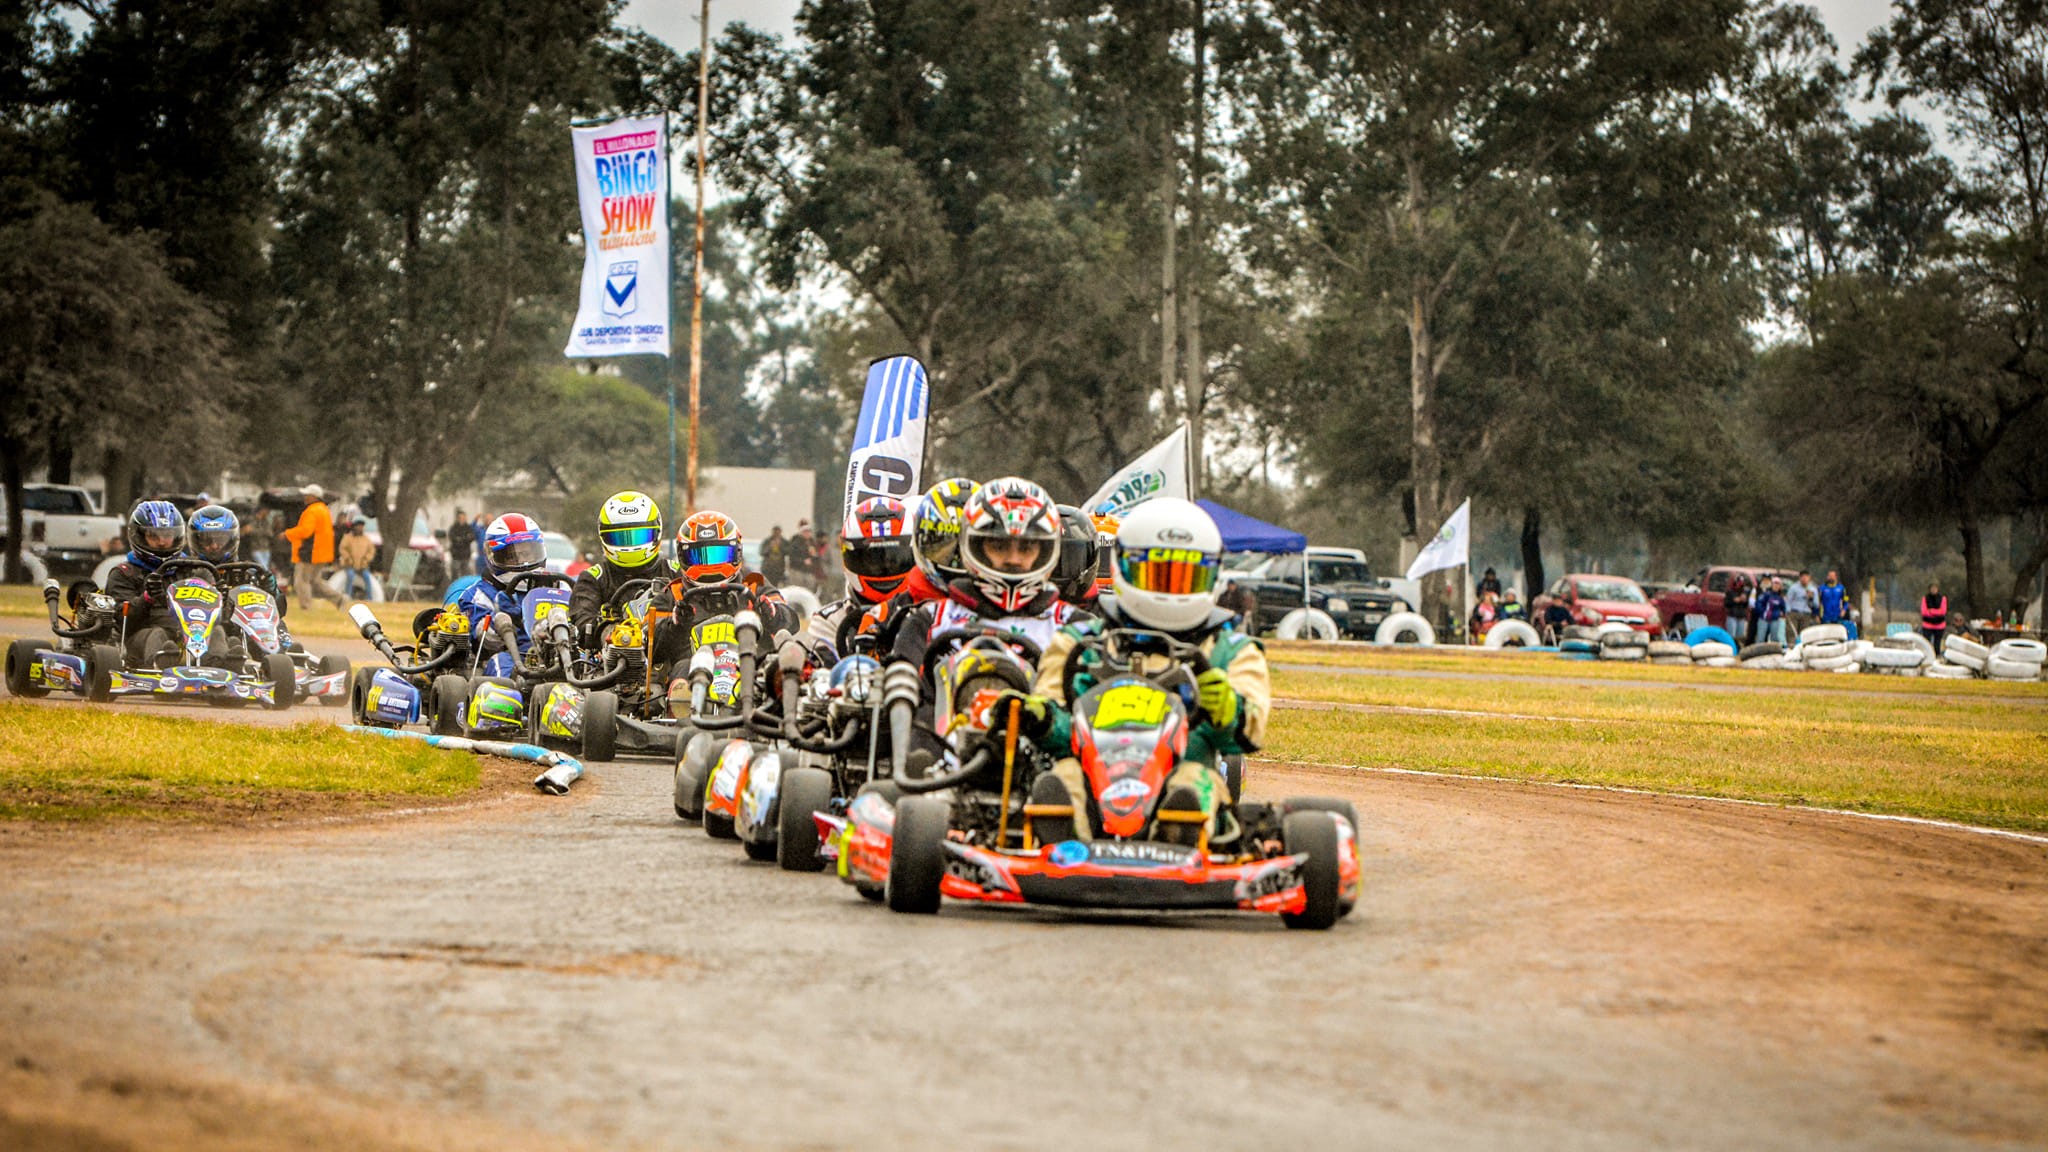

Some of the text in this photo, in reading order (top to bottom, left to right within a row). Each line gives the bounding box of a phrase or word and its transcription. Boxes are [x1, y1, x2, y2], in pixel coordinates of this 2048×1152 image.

[596, 142, 606, 153] EL
[595, 150, 657, 196] BINGO
[601, 192, 656, 235] SHOW
[595, 326, 632, 336] DEPORTIVO
[634, 325, 663, 334] COMERCIO
[175, 586, 218, 603] 815
